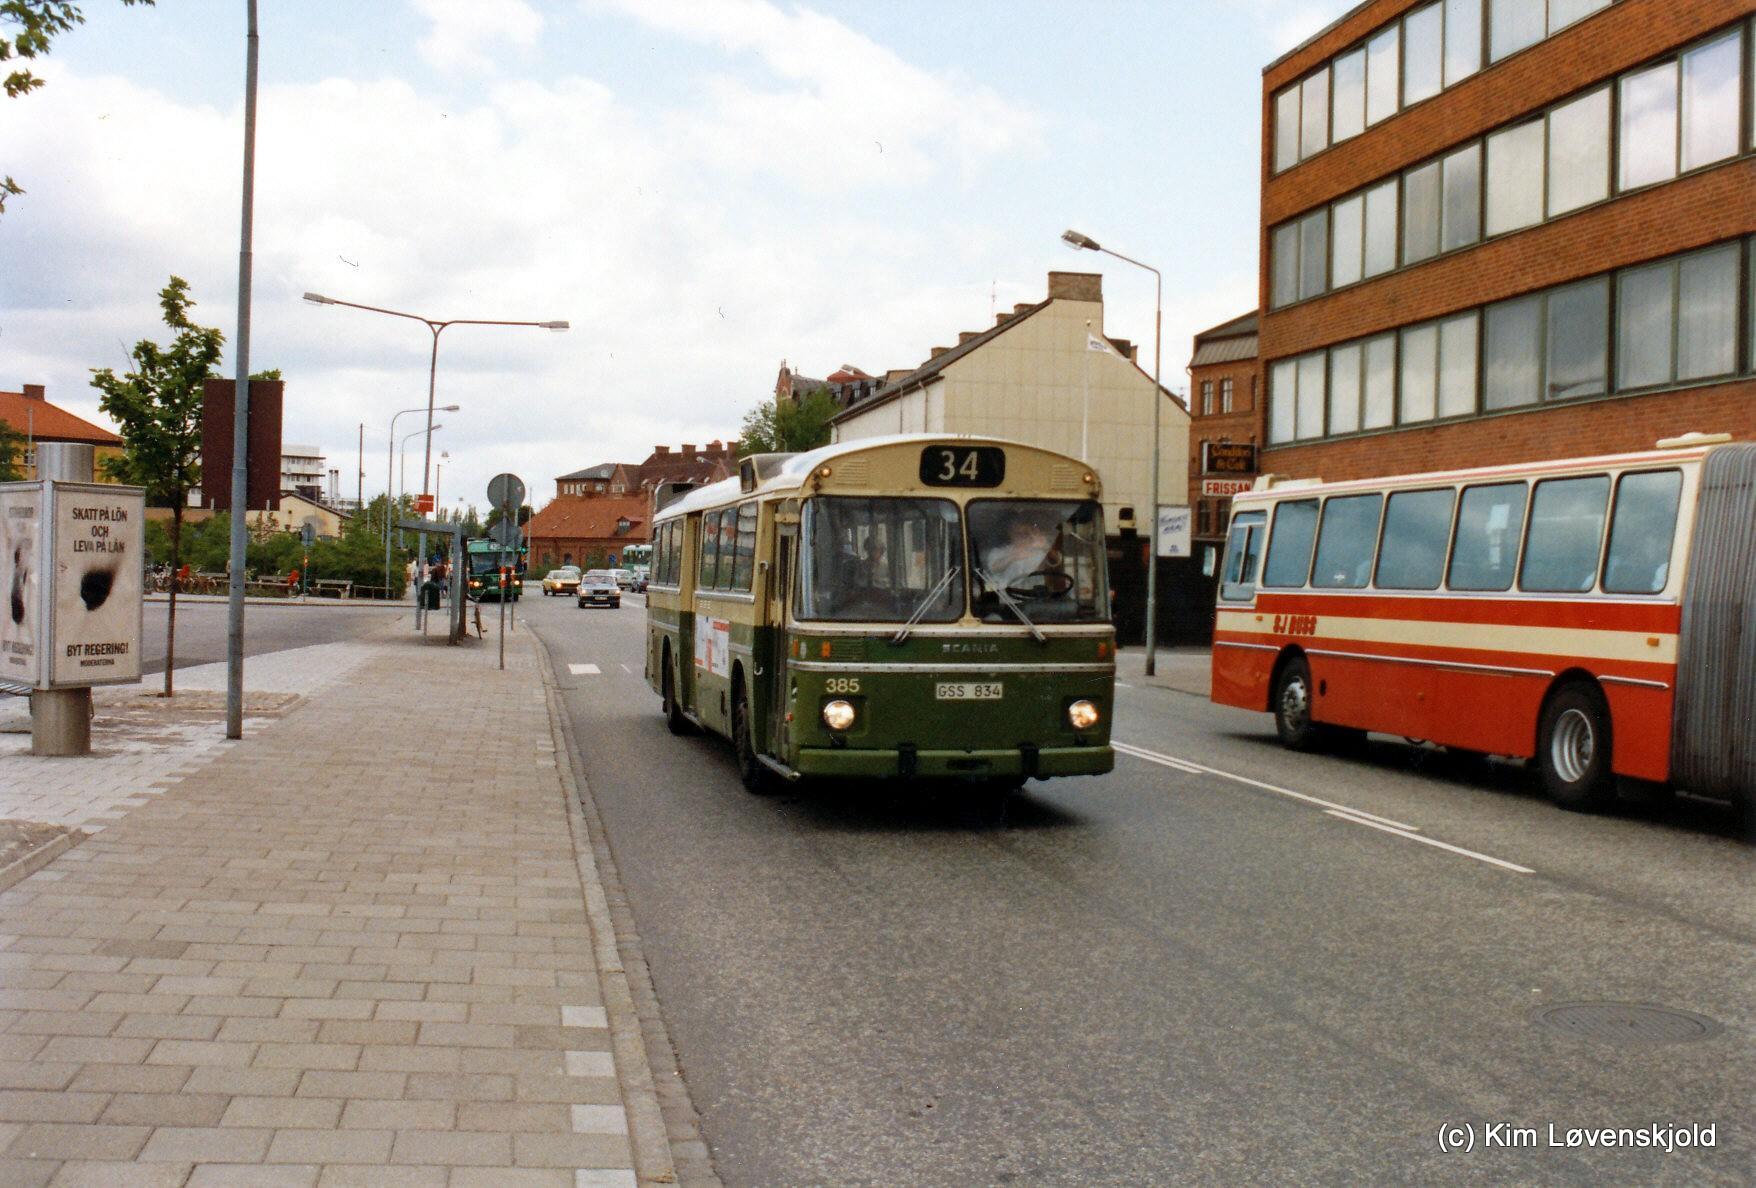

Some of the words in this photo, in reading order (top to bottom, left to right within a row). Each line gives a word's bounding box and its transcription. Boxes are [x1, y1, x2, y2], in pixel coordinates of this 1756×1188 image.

[938, 451, 978, 480] 34
[72, 507, 98, 521] SKATT
[99, 505, 110, 521] PÅ
[111, 507, 128, 522] LÖN
[91, 525, 109, 538] OCH
[73, 540, 95, 553] LEVA
[108, 538, 125, 553] LÅN
[1273, 614, 1288, 634] SJ
[67, 644, 83, 657] BYT
[84, 642, 129, 656] REGERING!
[942, 643, 998, 653] SCANIA
[825, 678, 860, 693] 385
[938, 685, 965, 697] GSS
[974, 684, 1000, 697] 834
